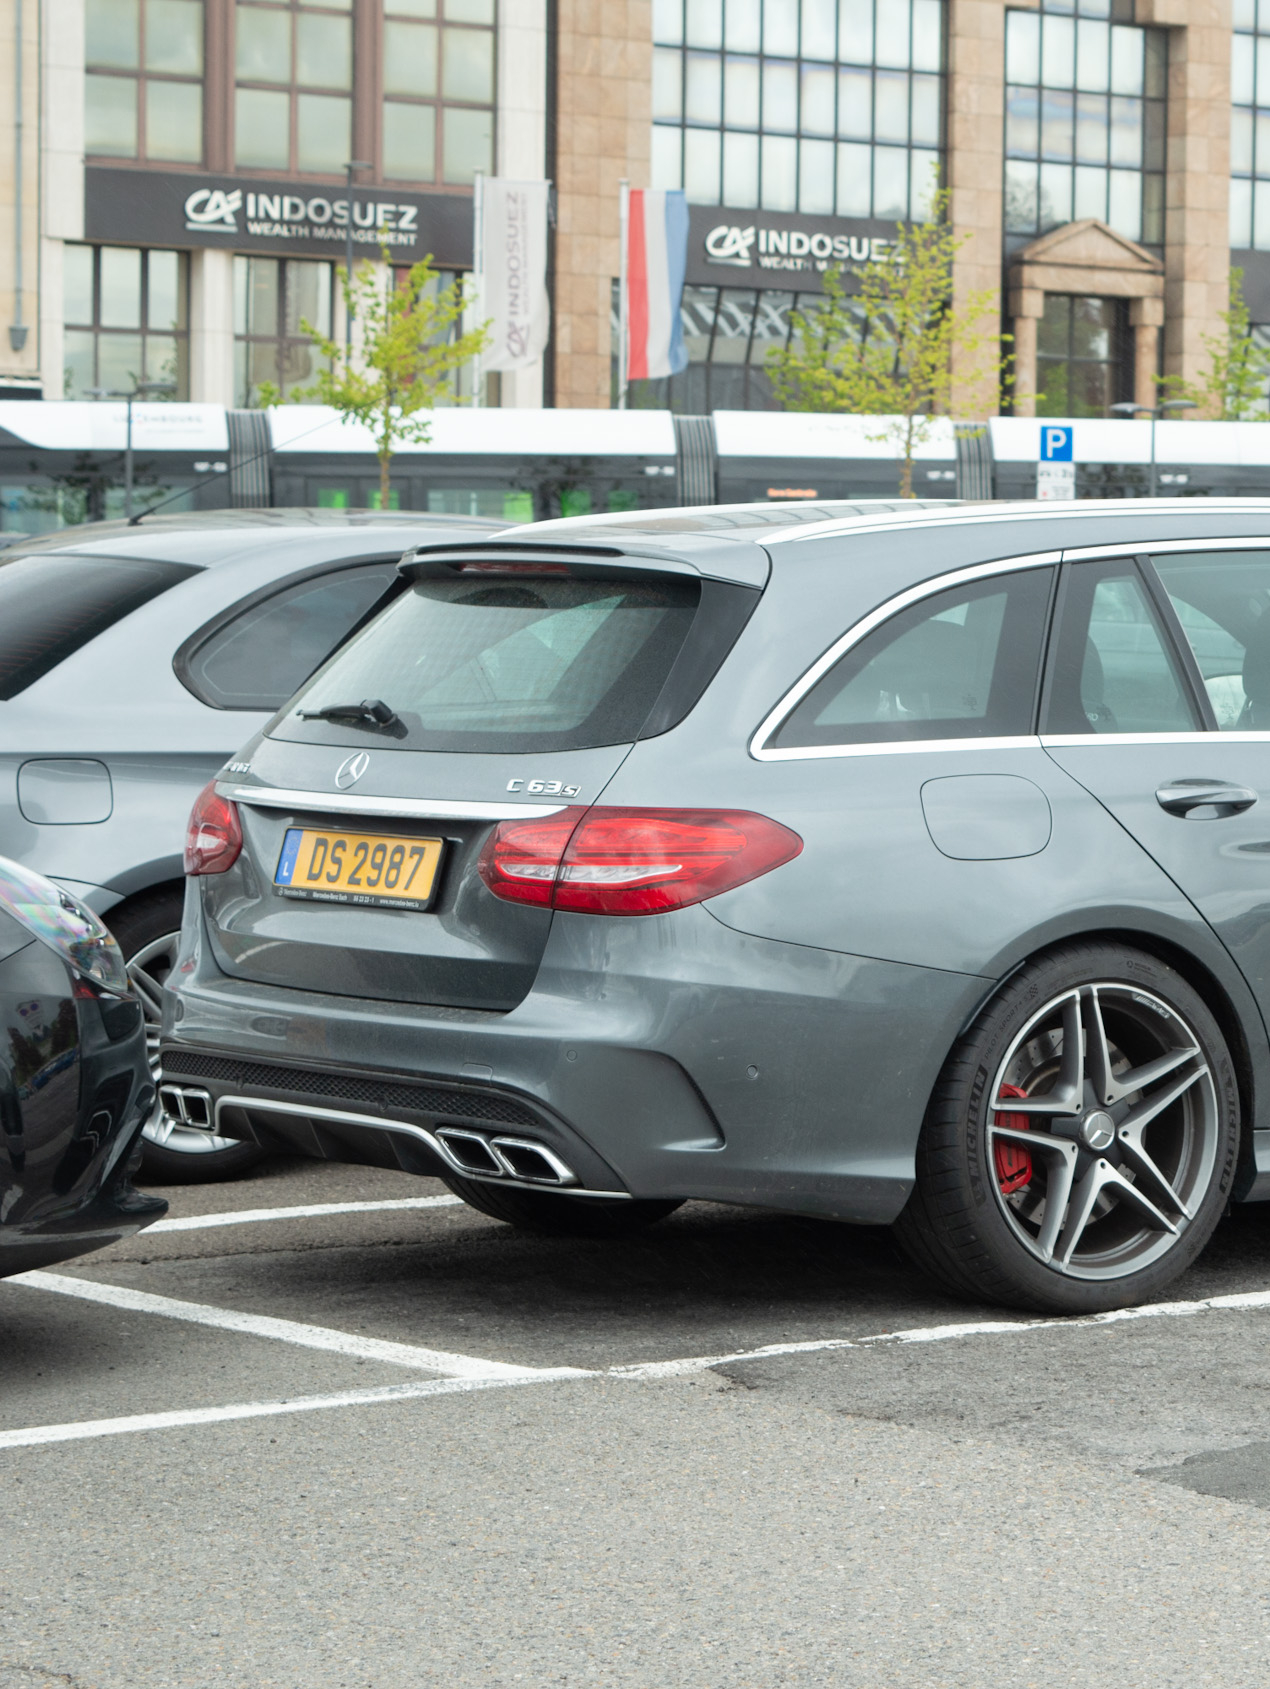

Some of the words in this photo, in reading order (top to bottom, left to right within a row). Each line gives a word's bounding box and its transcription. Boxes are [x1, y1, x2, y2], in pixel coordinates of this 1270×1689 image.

[247, 193, 417, 230] INDOSUEZ
[248, 221, 310, 238] WEALTH
[758, 229, 906, 262] INDOSUEZ
[506, 191, 521, 316] INDOSUEZ
[1047, 429, 1067, 458] P
[506, 778, 524, 793] C
[307, 837, 347, 883] DS
[347, 841, 426, 891] 2987
[967, 1068, 986, 1177] MICHELIN
